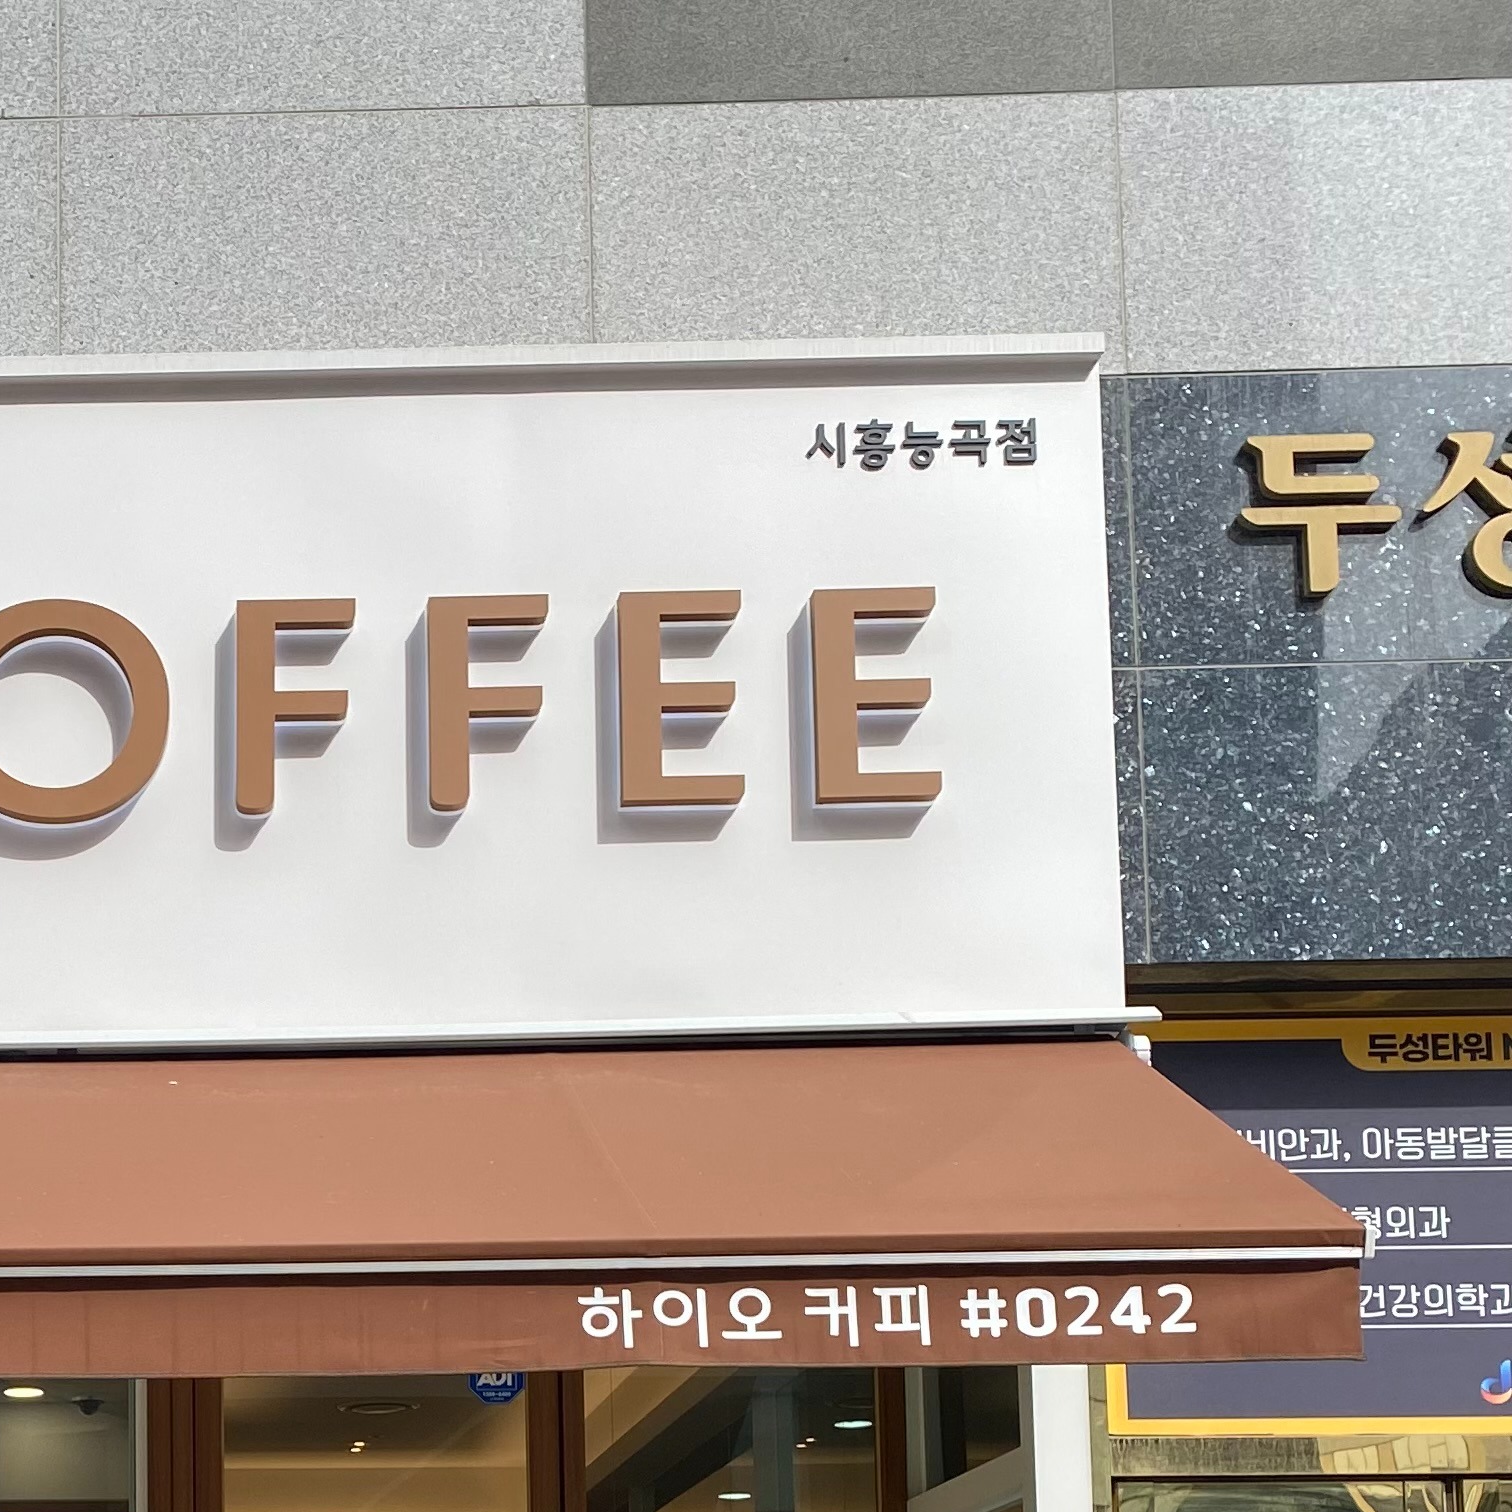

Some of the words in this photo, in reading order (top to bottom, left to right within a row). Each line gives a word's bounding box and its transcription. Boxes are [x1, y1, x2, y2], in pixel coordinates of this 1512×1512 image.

[806, 416, 1039, 470] 시흥능곡점
[1367, 1032, 1494, 1064] 두성타워
[577, 1286, 783, 1349] 하이오
[803, 1284, 931, 1348] 커피
[959, 1283, 1198, 1339] #0242
